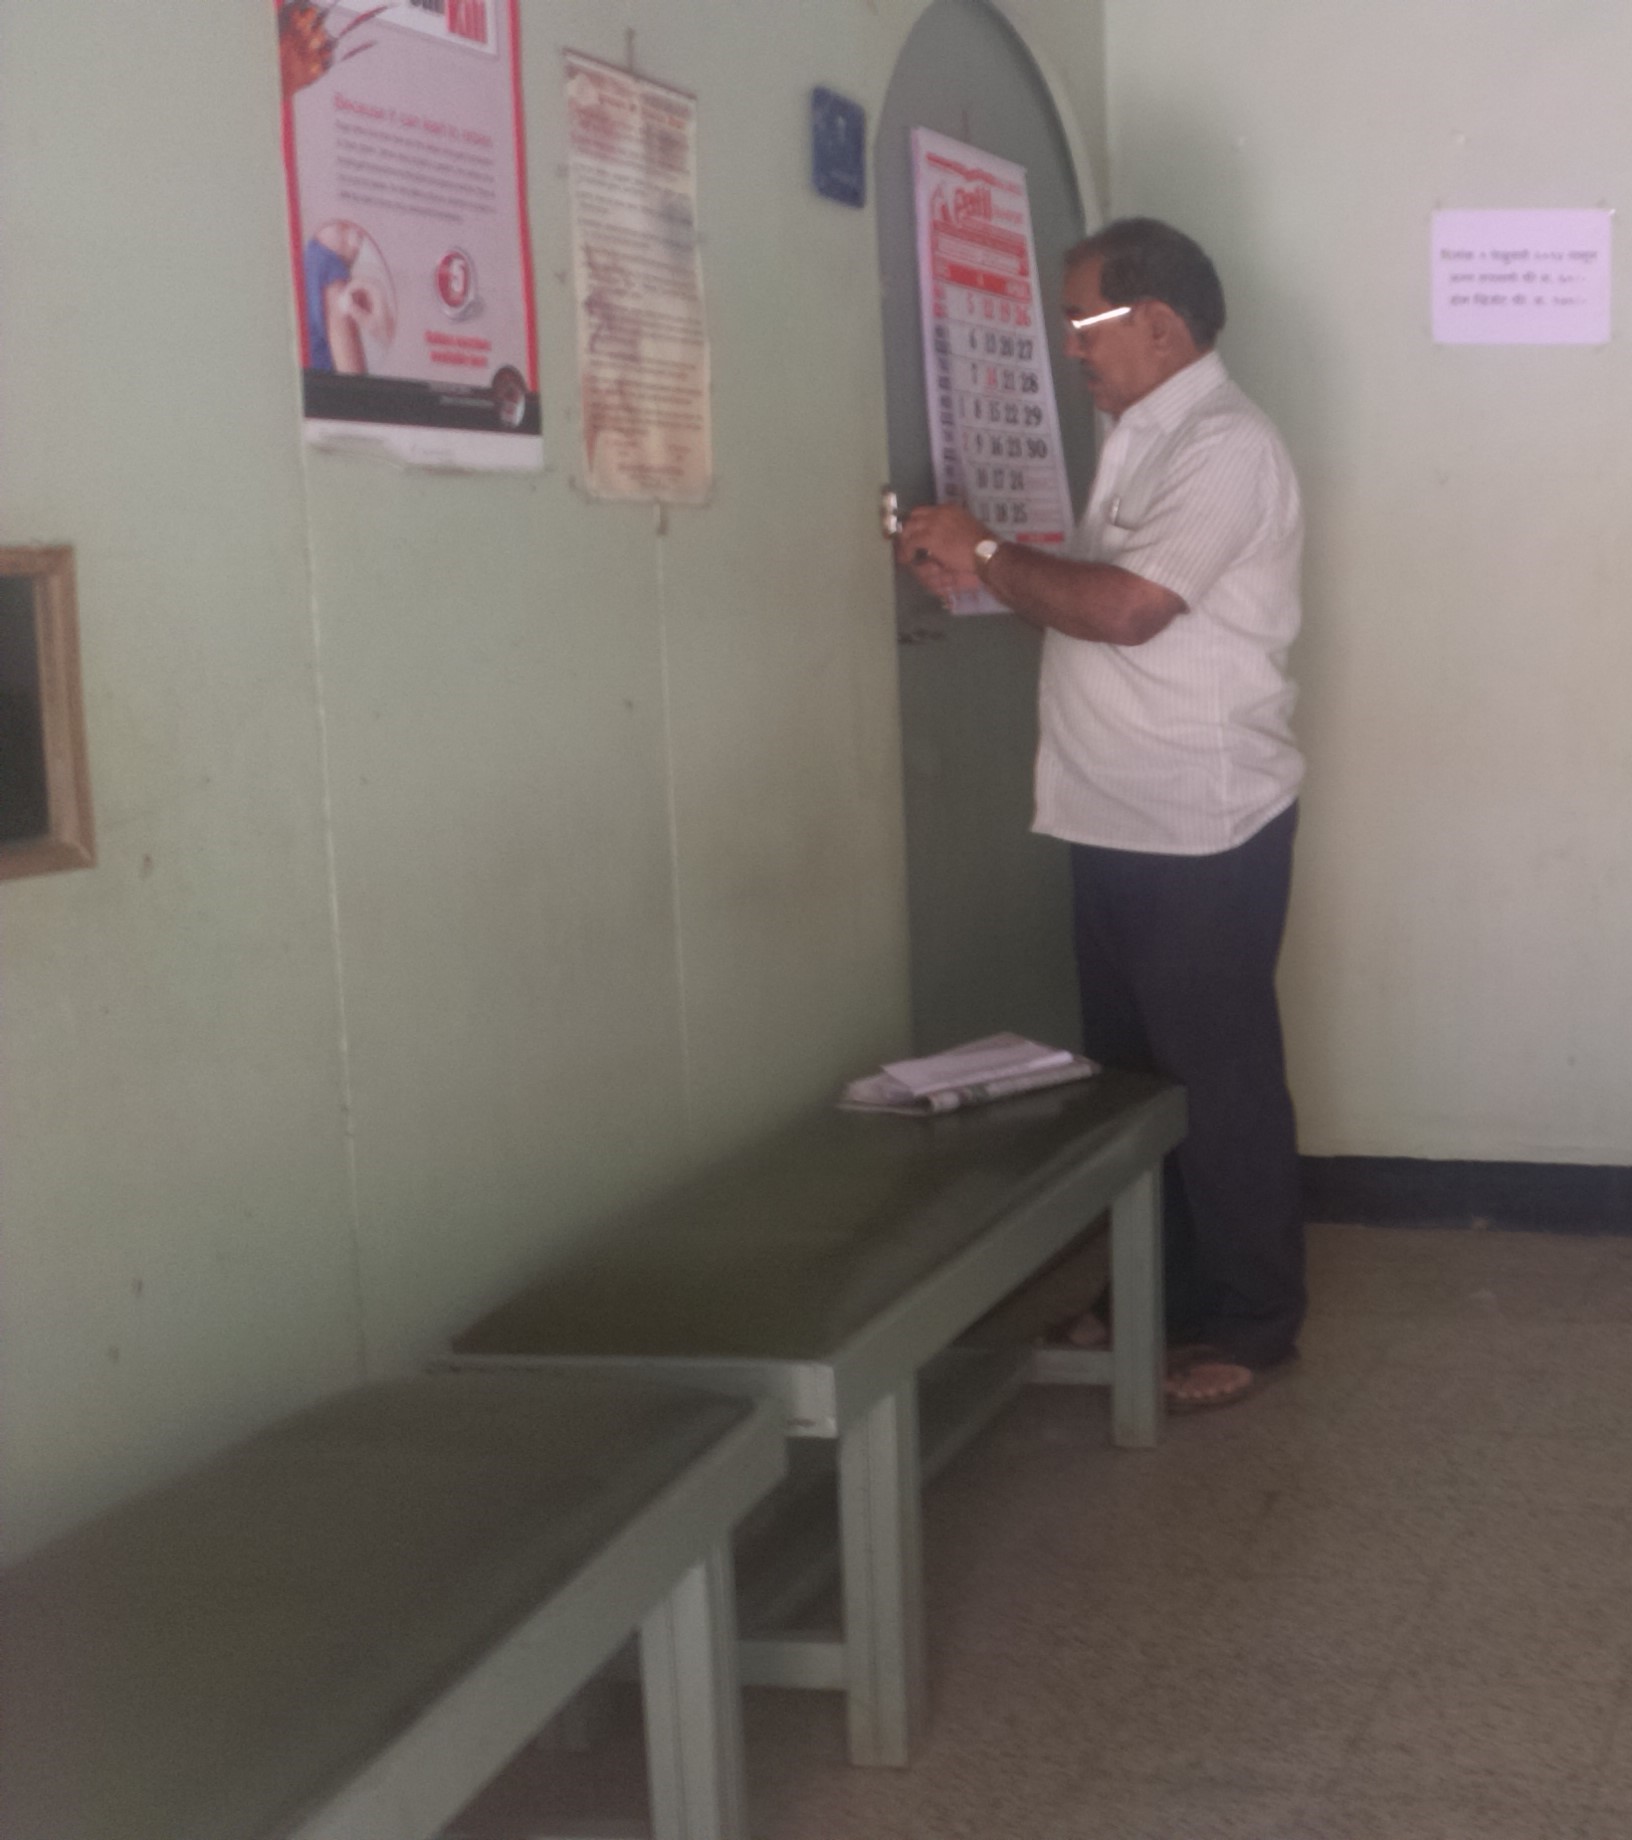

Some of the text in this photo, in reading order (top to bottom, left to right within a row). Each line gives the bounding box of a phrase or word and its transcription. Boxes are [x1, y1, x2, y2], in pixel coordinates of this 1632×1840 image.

[1017, 339, 1033, 360] 27
[1024, 406, 1043, 427] 29
[1026, 438, 1048, 460] 30
